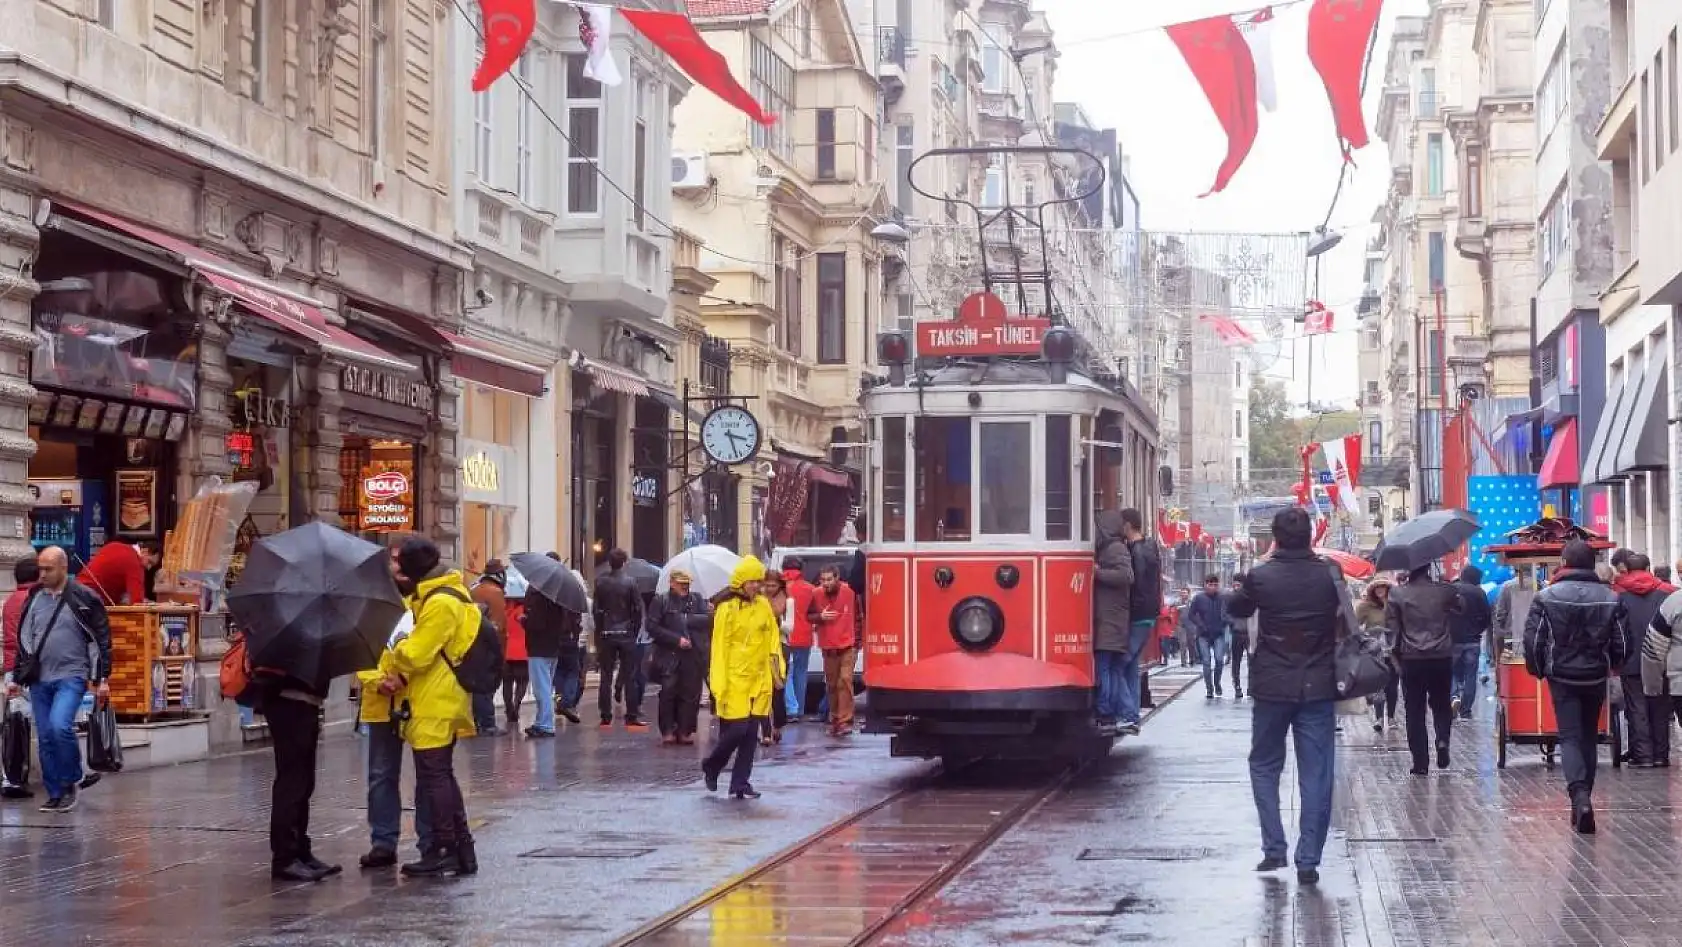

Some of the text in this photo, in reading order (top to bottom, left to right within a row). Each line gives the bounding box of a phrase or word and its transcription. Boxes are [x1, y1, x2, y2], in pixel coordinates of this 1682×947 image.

[978, 296, 985, 317] 1
[928, 325, 979, 347] TAKSİM
[994, 323, 1041, 345] TÜNEL
